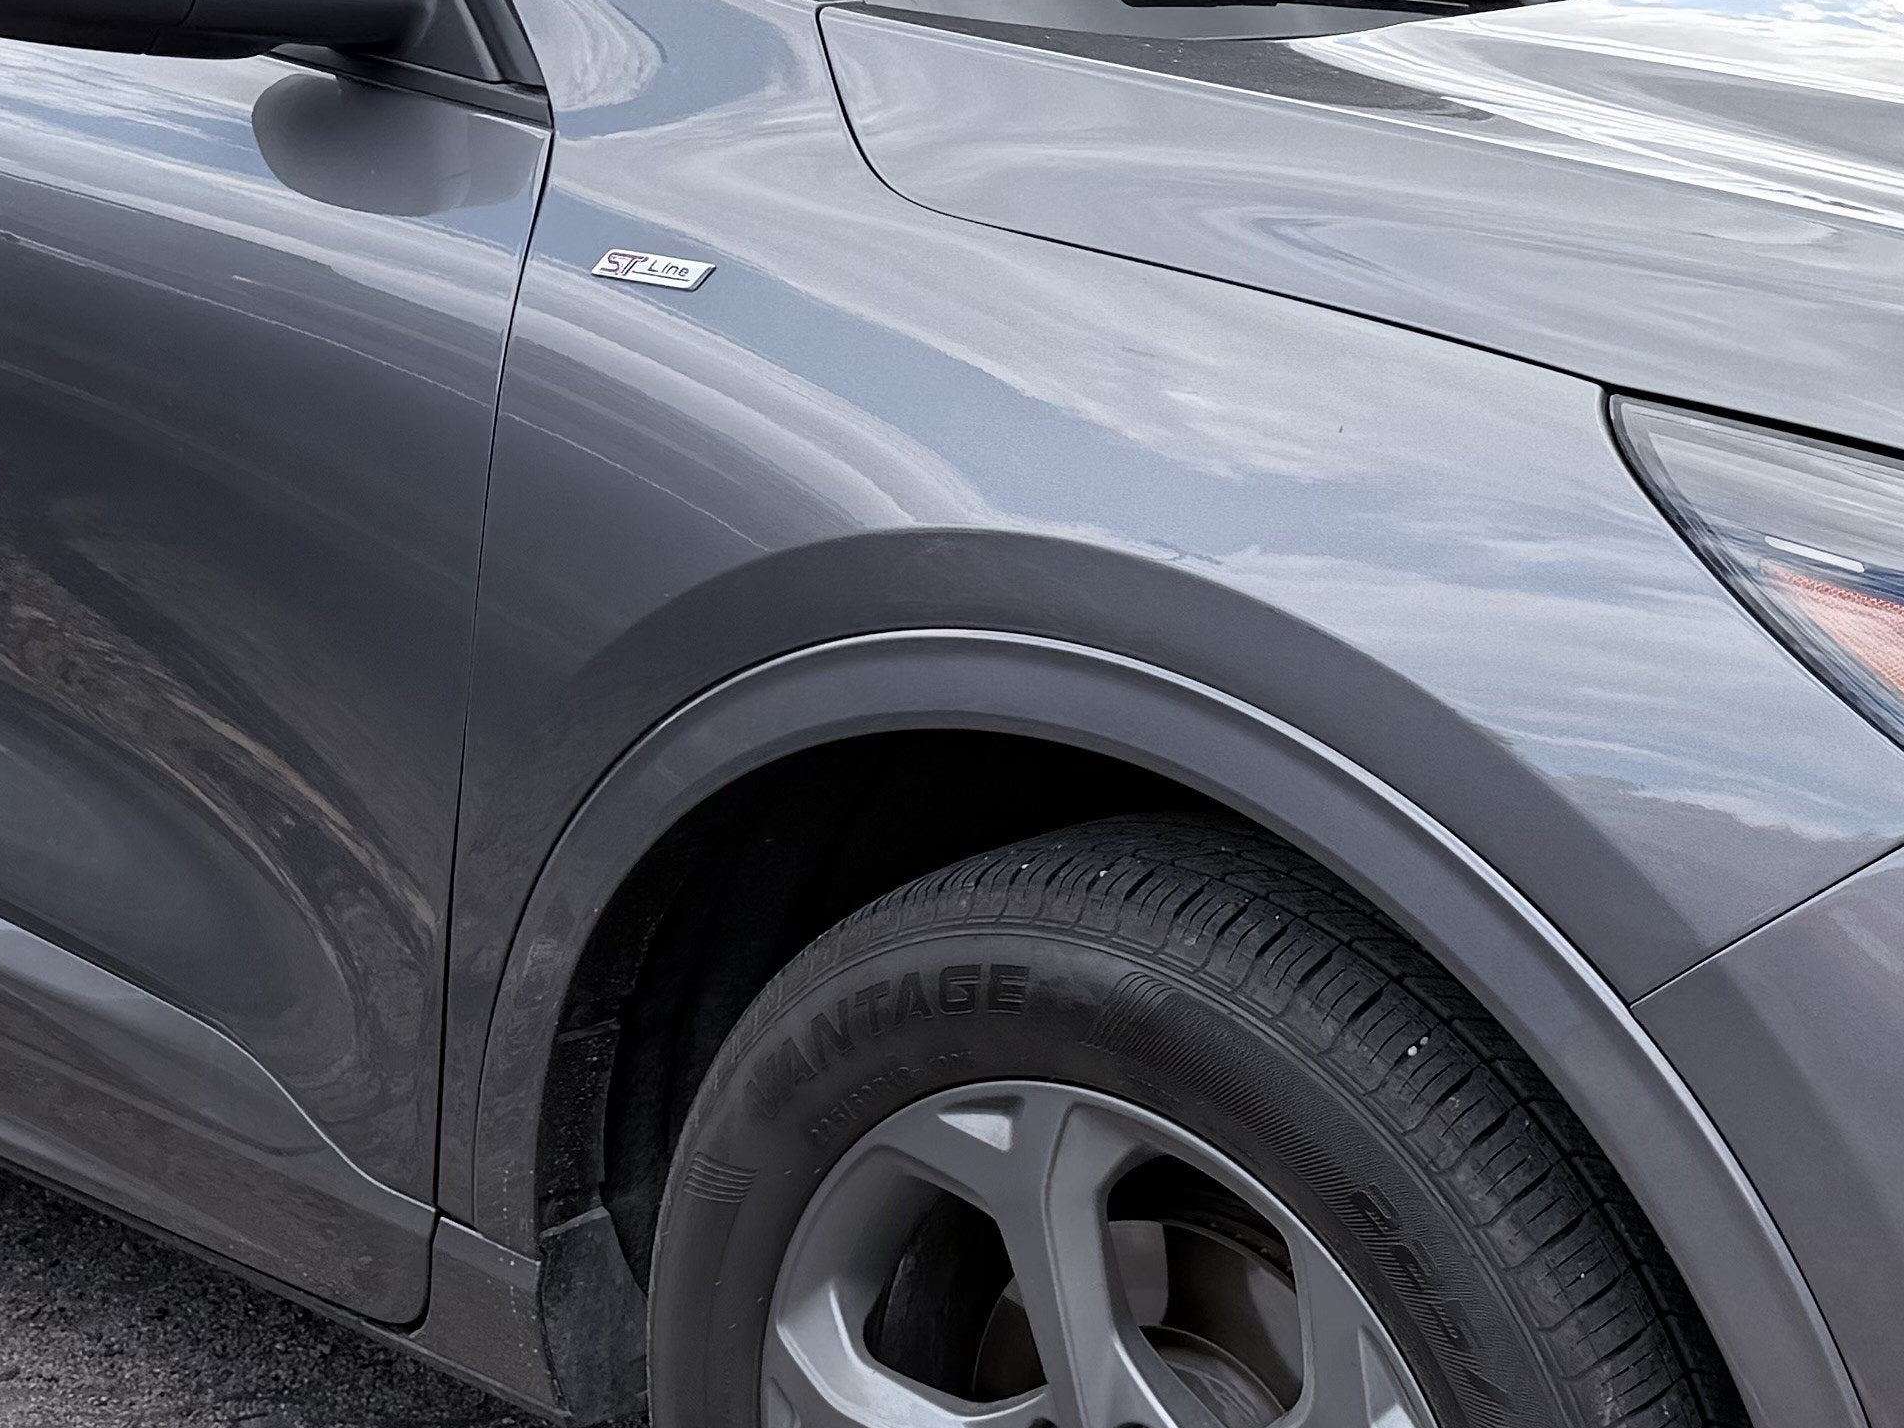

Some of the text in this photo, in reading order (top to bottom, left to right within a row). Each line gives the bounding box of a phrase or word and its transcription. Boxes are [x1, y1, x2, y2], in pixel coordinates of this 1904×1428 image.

[600, 251, 690, 278] ST Line
[746, 963, 1030, 1120] VANTAGE
